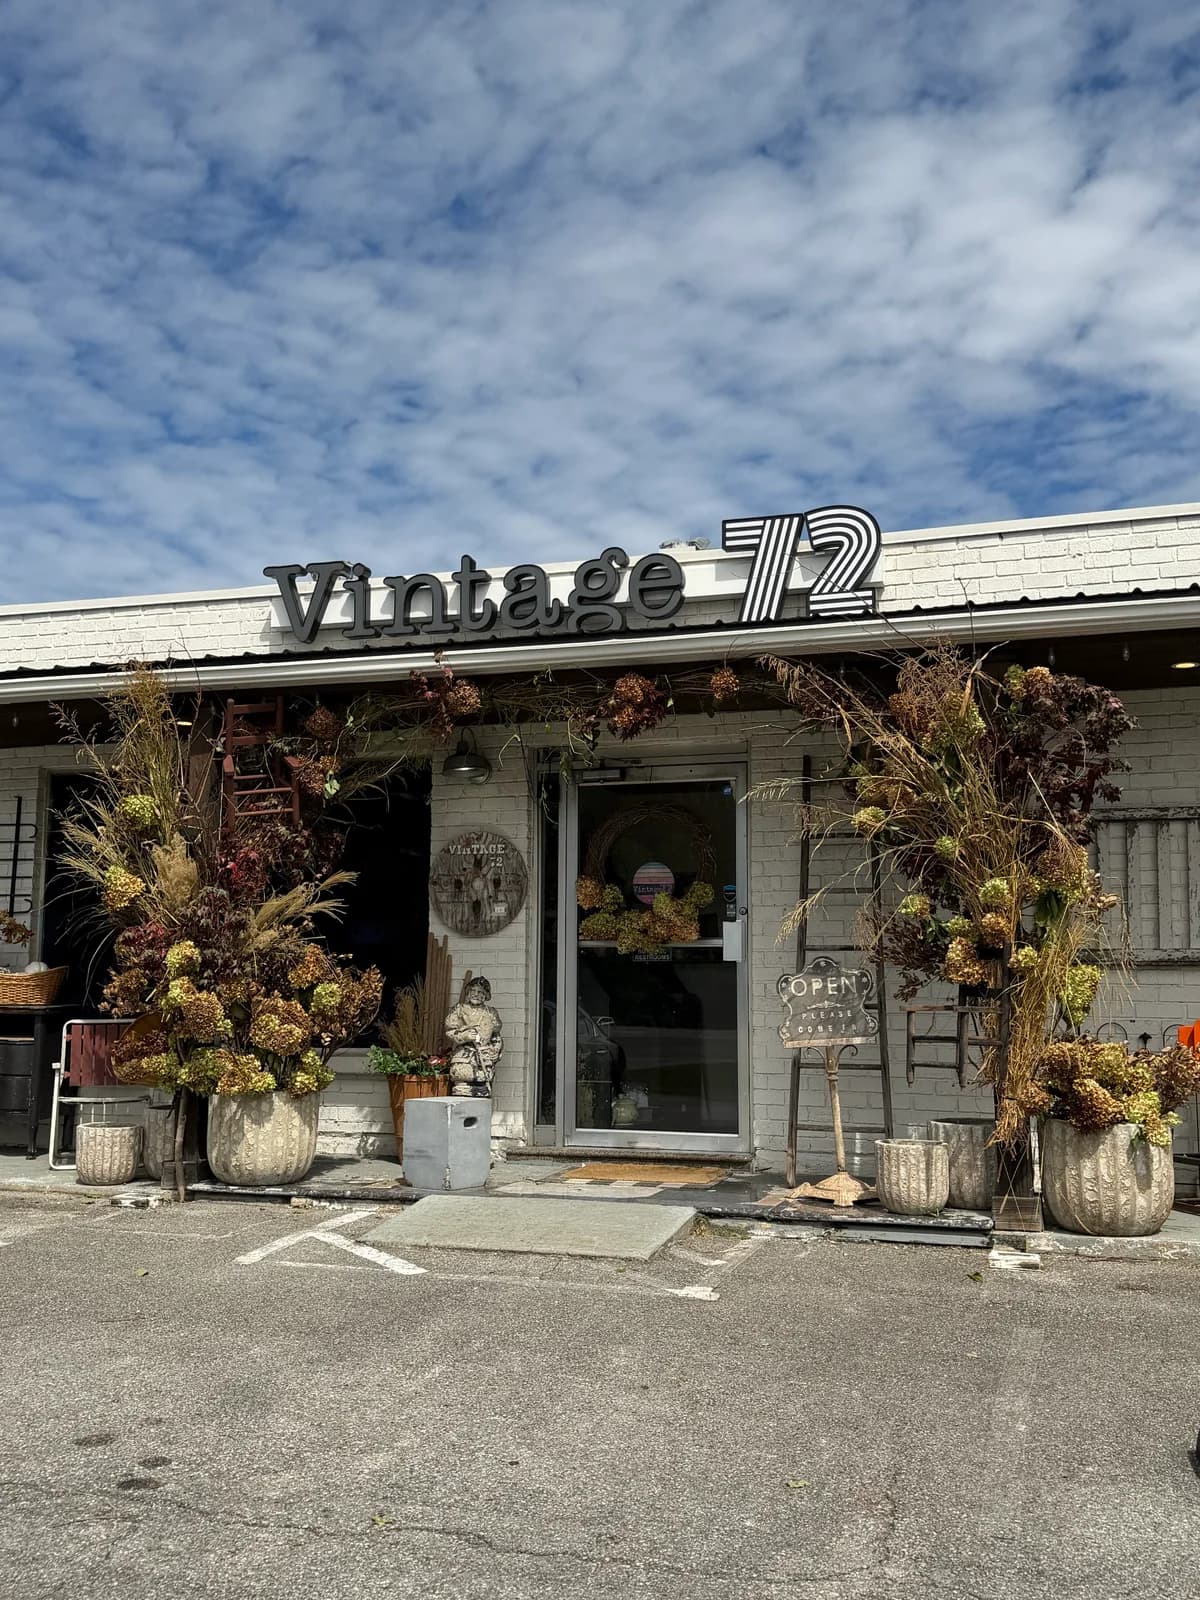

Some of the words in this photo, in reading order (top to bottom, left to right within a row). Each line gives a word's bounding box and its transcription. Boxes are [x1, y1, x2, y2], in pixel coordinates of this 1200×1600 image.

[263, 547, 685, 643] Vintage
[722, 505, 882, 622] 72
[791, 976, 857, 996] OPEN
[802, 1010, 852, 1020] PLEASE
[798, 1025, 833, 1033] COME
